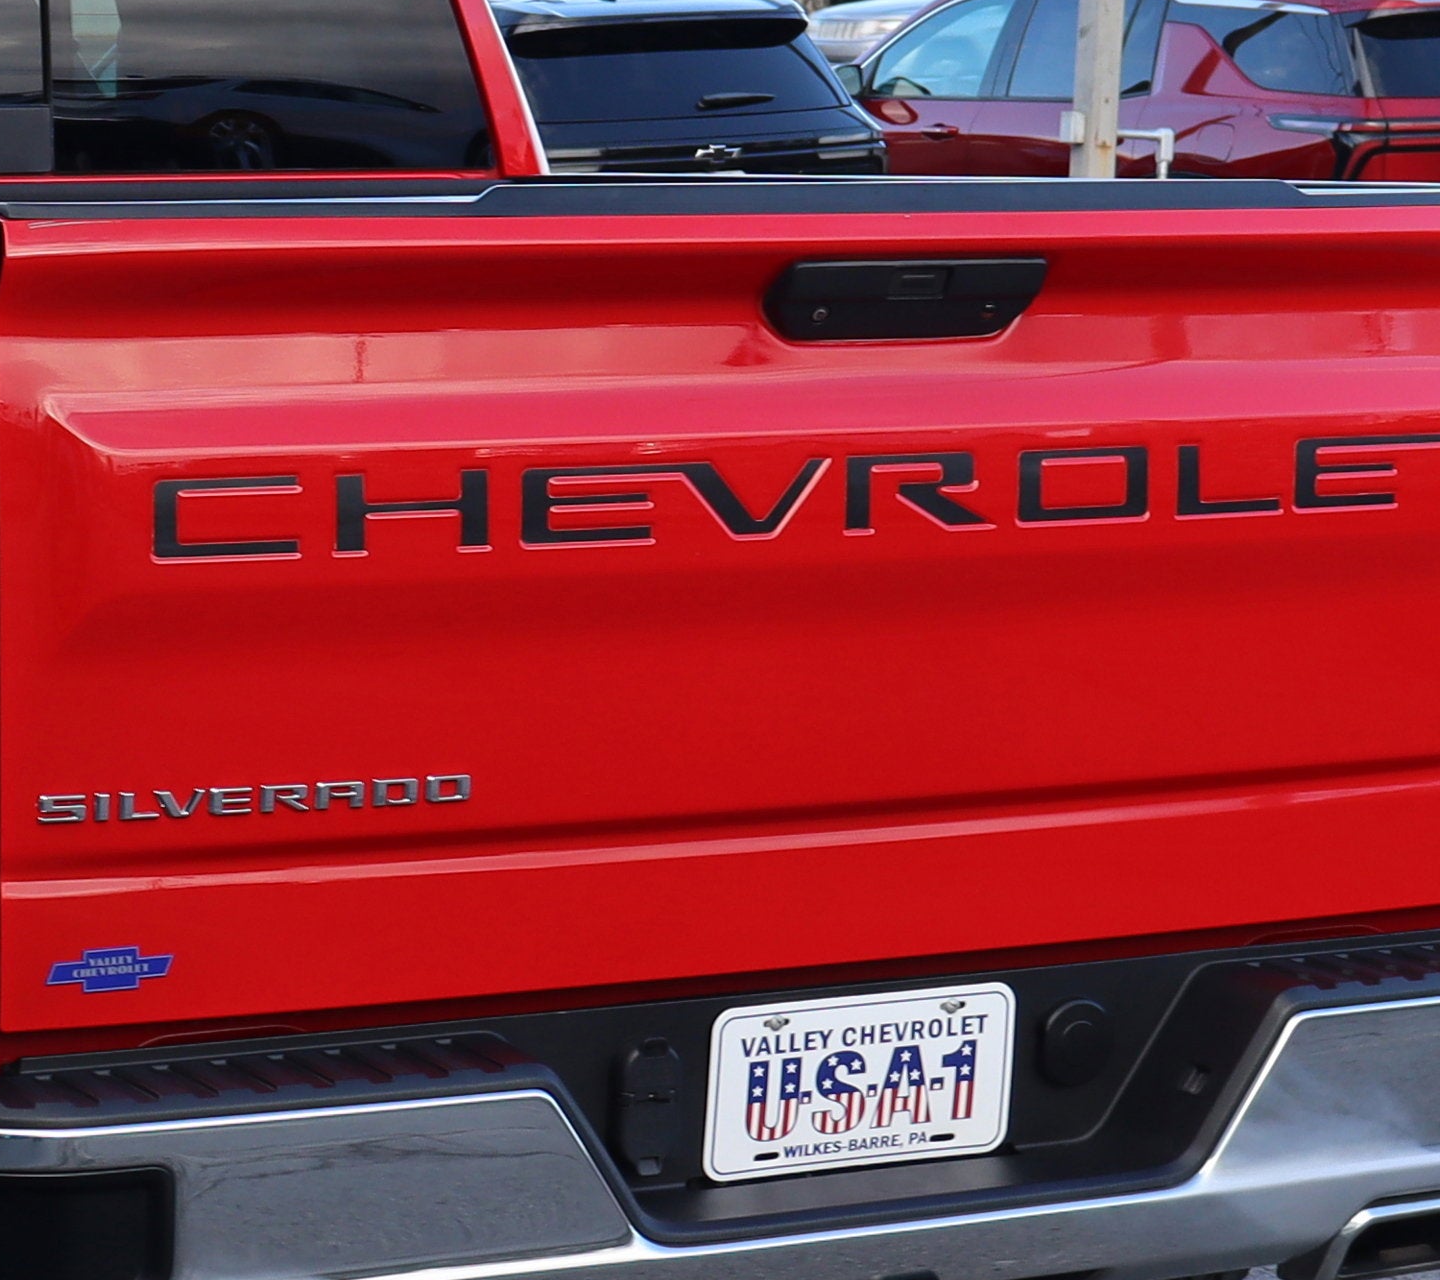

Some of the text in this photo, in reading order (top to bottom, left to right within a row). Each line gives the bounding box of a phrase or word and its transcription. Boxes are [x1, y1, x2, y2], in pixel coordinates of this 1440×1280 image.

[37, 773, 472, 824] SILVERADO
[72, 963, 150, 978] CHEVROLET
[88, 955, 134, 967] VALLEY
[741, 1014, 989, 1058] VALLEY CHEVROLET
[783, 1131, 931, 1159] WILKES-BARRE, PA
